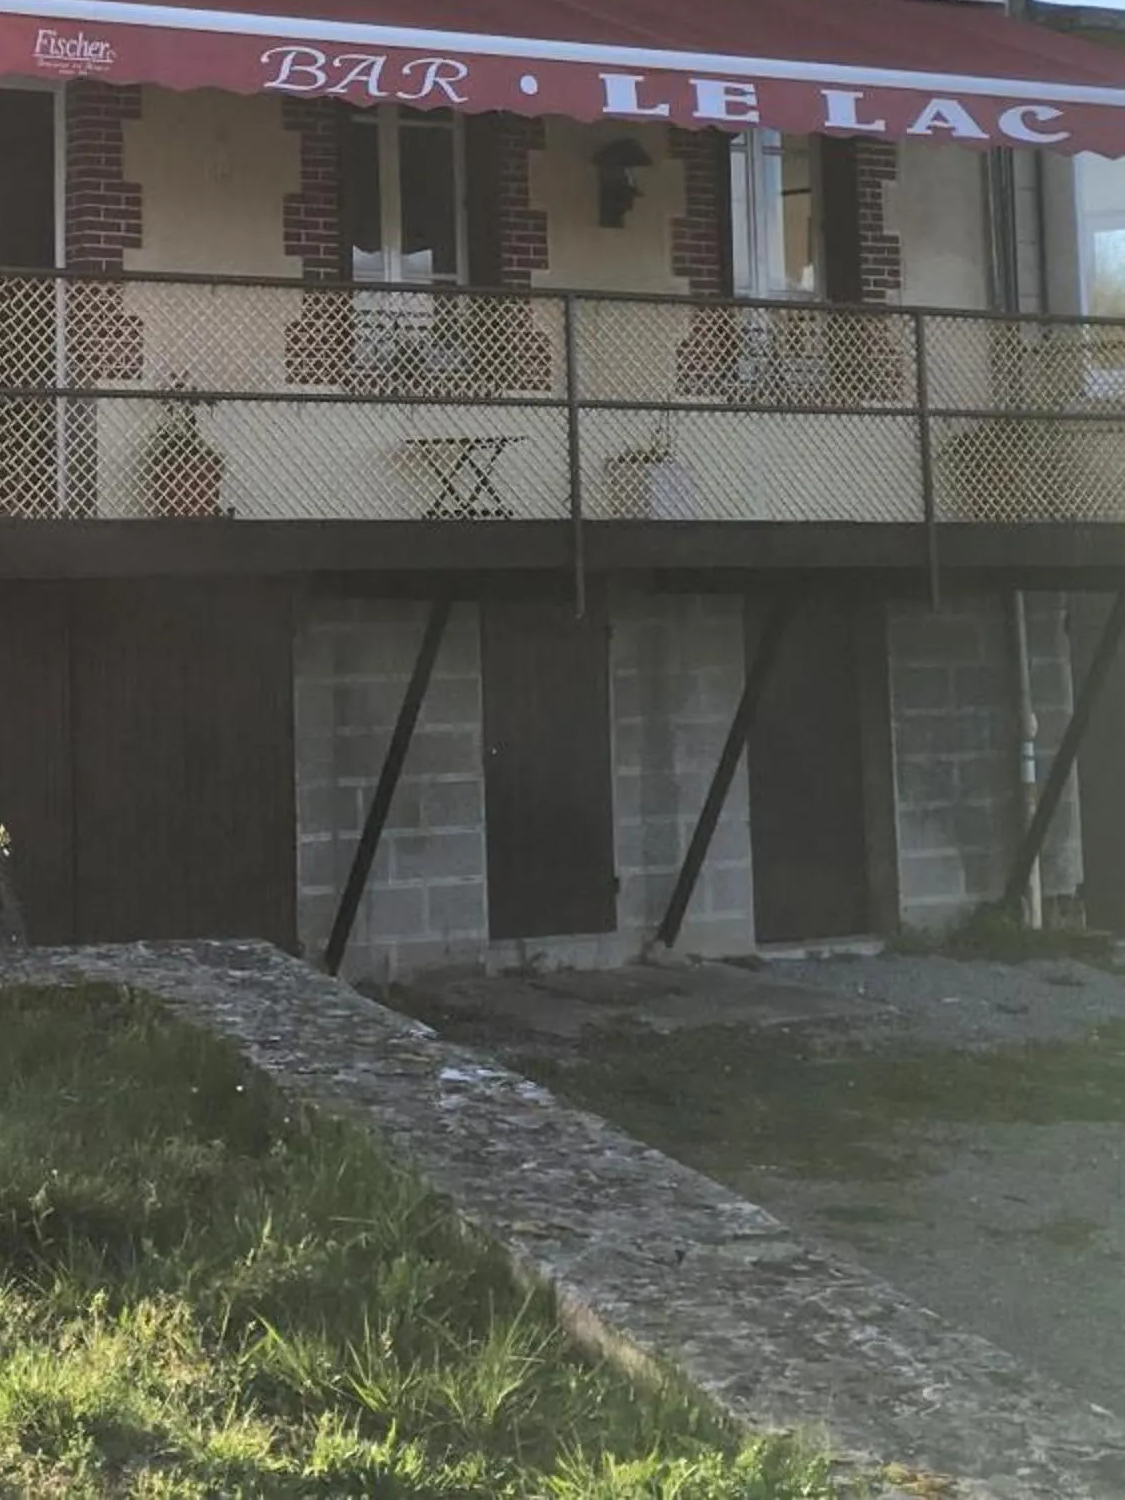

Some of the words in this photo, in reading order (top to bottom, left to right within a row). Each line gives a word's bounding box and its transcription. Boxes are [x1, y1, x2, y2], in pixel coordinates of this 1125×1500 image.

[35, 29, 110, 57] Fischer
[260, 45, 469, 104] BAR
[599, 73, 759, 122] LE
[820, 89, 1071, 143] LAC
